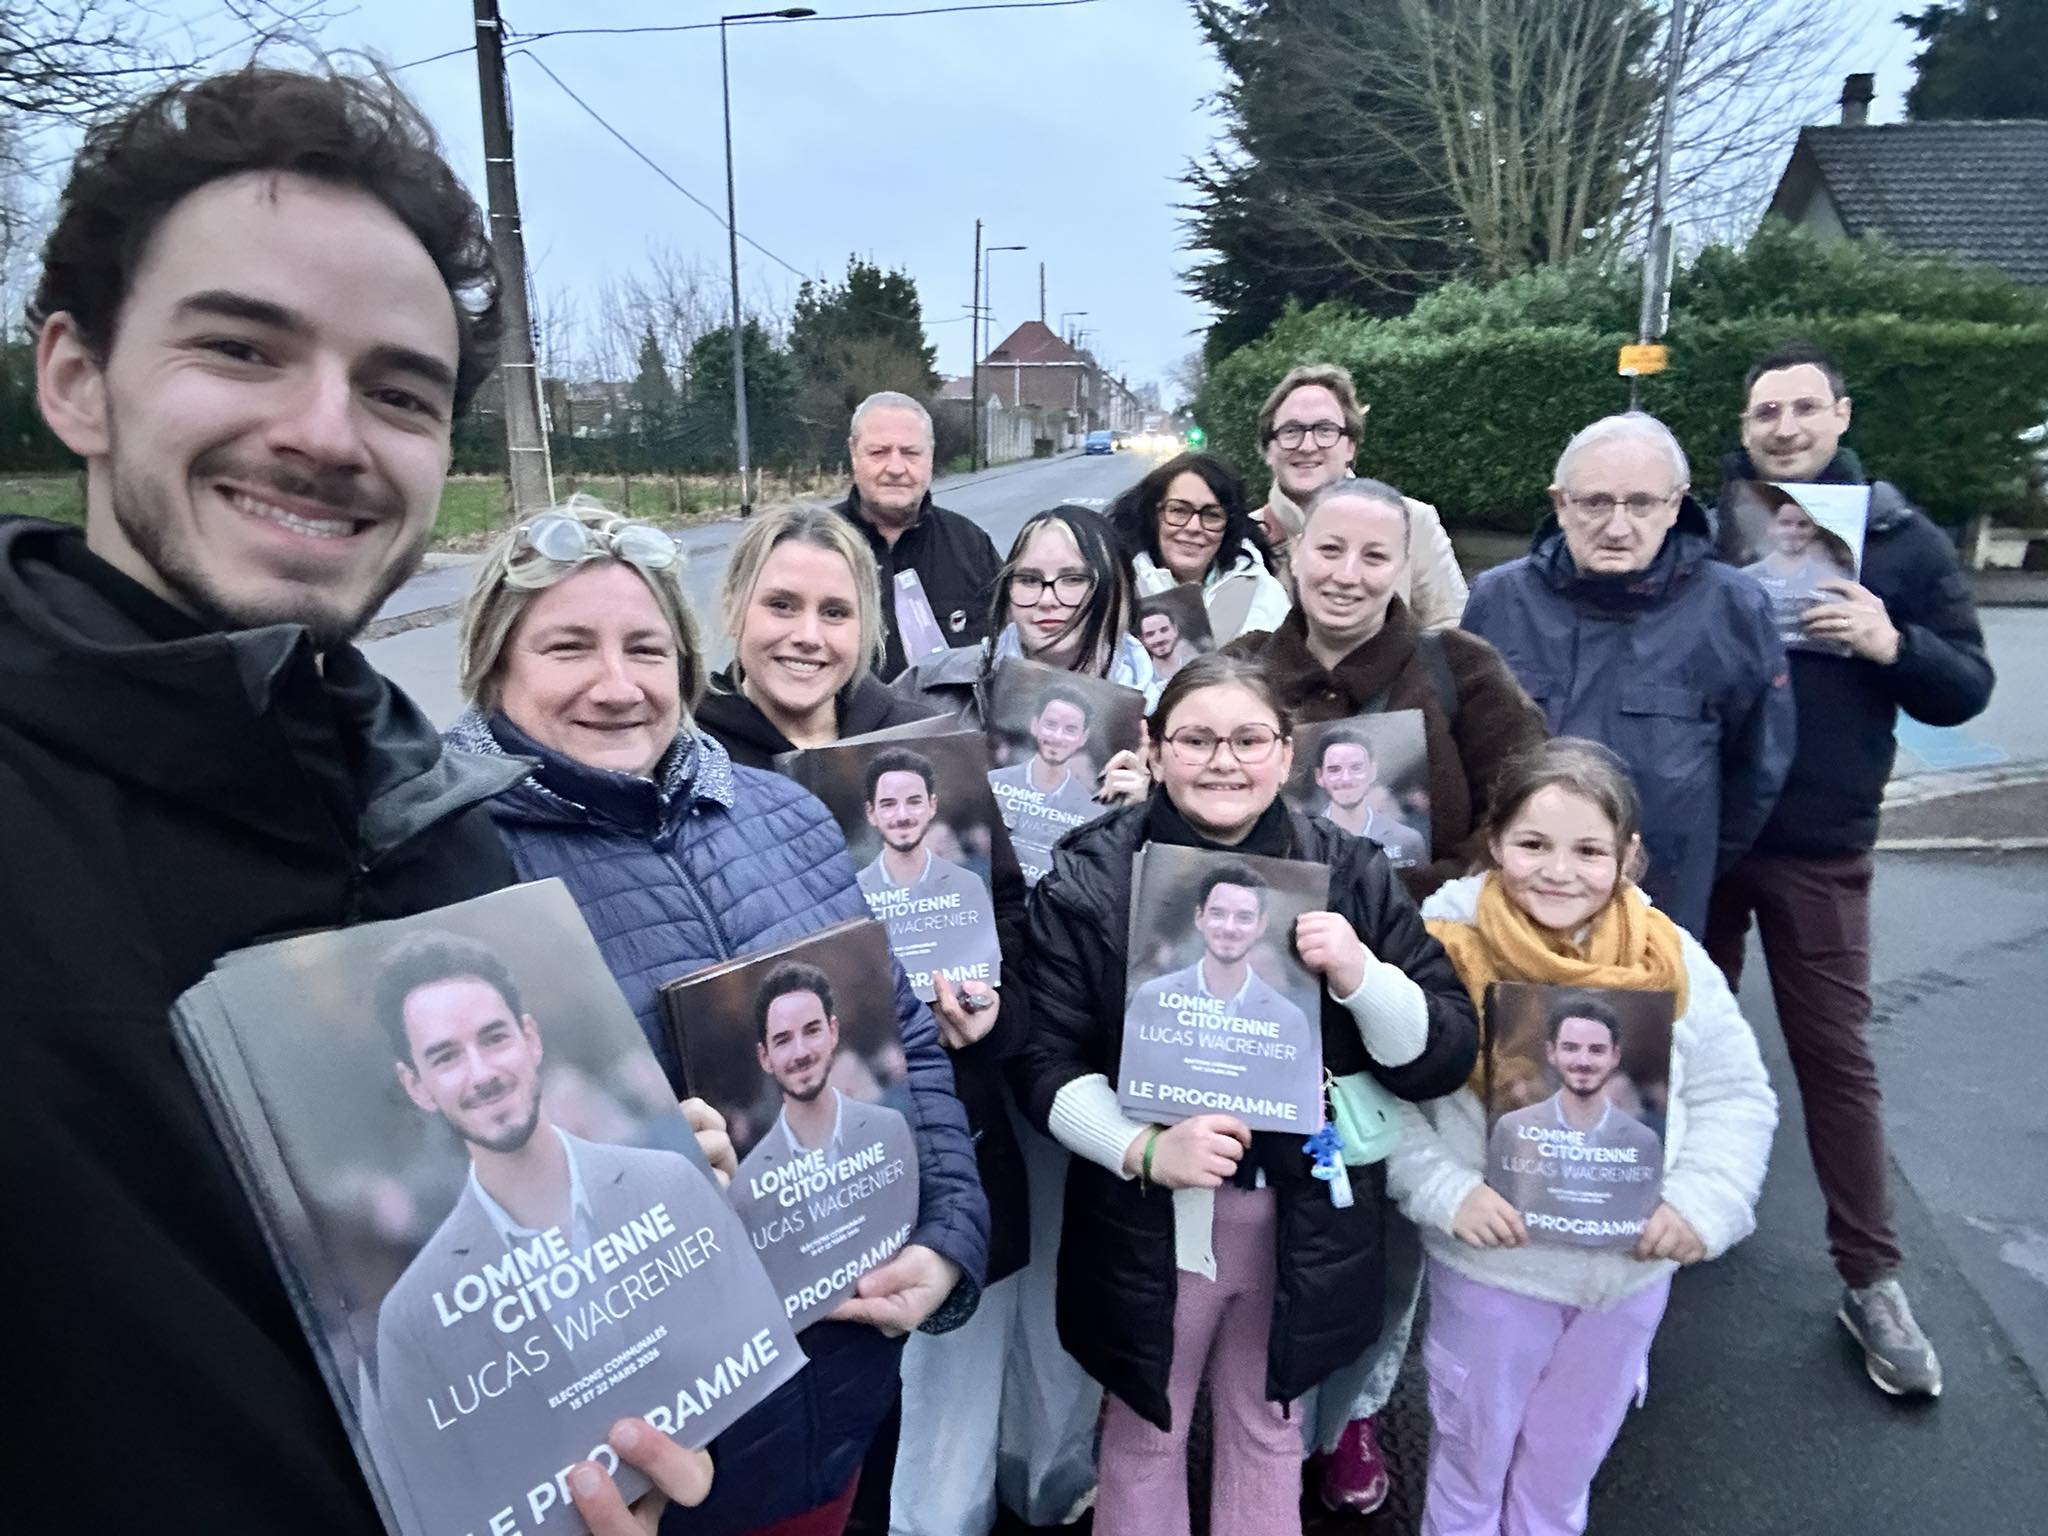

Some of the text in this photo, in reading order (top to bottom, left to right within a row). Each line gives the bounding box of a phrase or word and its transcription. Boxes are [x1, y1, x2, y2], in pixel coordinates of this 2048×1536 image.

[992, 781, 1046, 805] LOMME
[1006, 798, 1086, 827] CITOYENNE
[892, 910, 979, 935] WACRENIER
[1158, 991, 1226, 1015] LOMME
[1139, 1025, 1297, 1061] LUCAS WACRENIER
[1177, 1010, 1281, 1039] CITOYENNE
[1129, 1080, 1298, 1121] LE PROGRAMME
[1517, 1124, 1586, 1147] LOMME
[1537, 1142, 1640, 1163] CITOYENNE
[750, 1148, 826, 1200] LOMME
[779, 1141, 886, 1207] CITOYENNE
[752, 1210, 806, 1250] UCAS
[807, 1159, 905, 1223] WACRENIER
[432, 1225, 571, 1328] LOMME
[492, 1202, 677, 1334] CITOYENNE
[784, 1223, 912, 1320] PROGRAMME
[427, 1225, 722, 1430] LUCAS WACRENIER
[548, 1367, 605, 1409] ELECTIONS
[581, 1388, 596, 1404] ET
[608, 1362, 639, 1387] MARS
